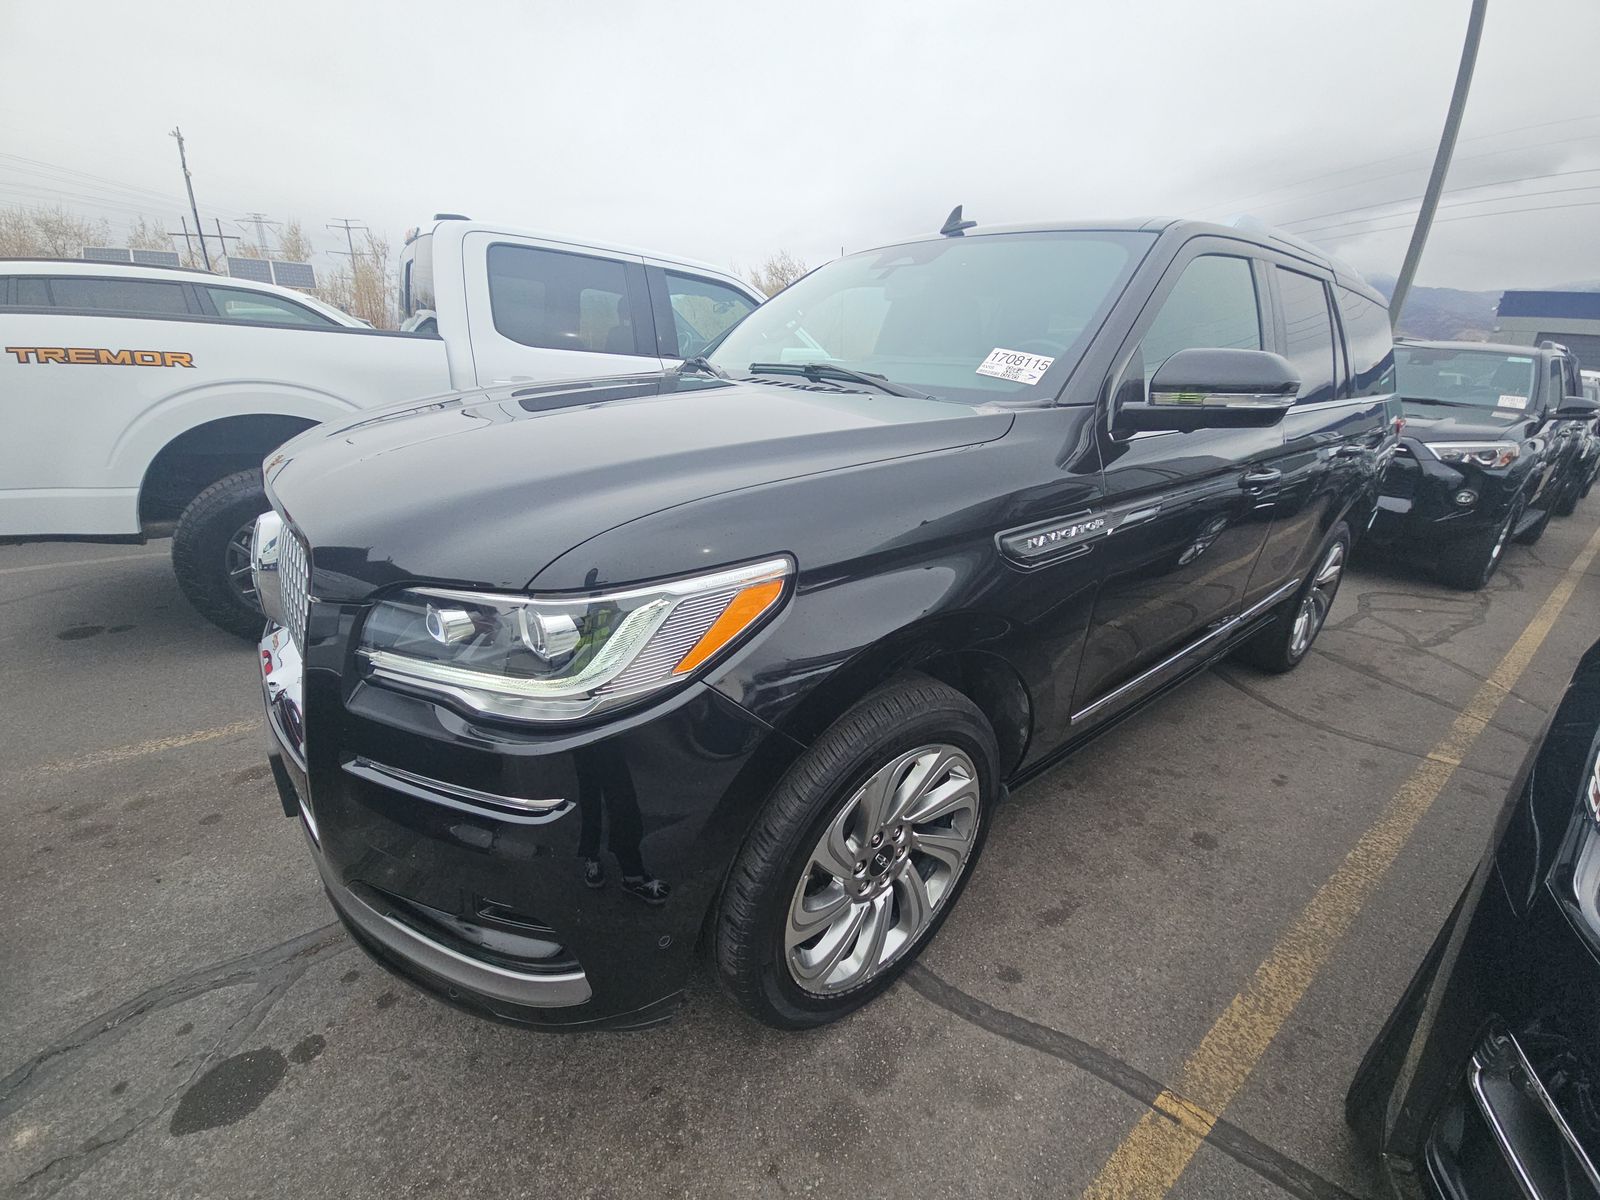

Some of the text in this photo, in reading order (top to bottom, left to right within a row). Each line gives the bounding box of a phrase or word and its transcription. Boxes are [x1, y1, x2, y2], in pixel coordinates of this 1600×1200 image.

[5, 346, 197, 368] TREMOR
[991, 351, 1051, 371] 1708115
[1027, 518, 1105, 549] NAVIGATOR
